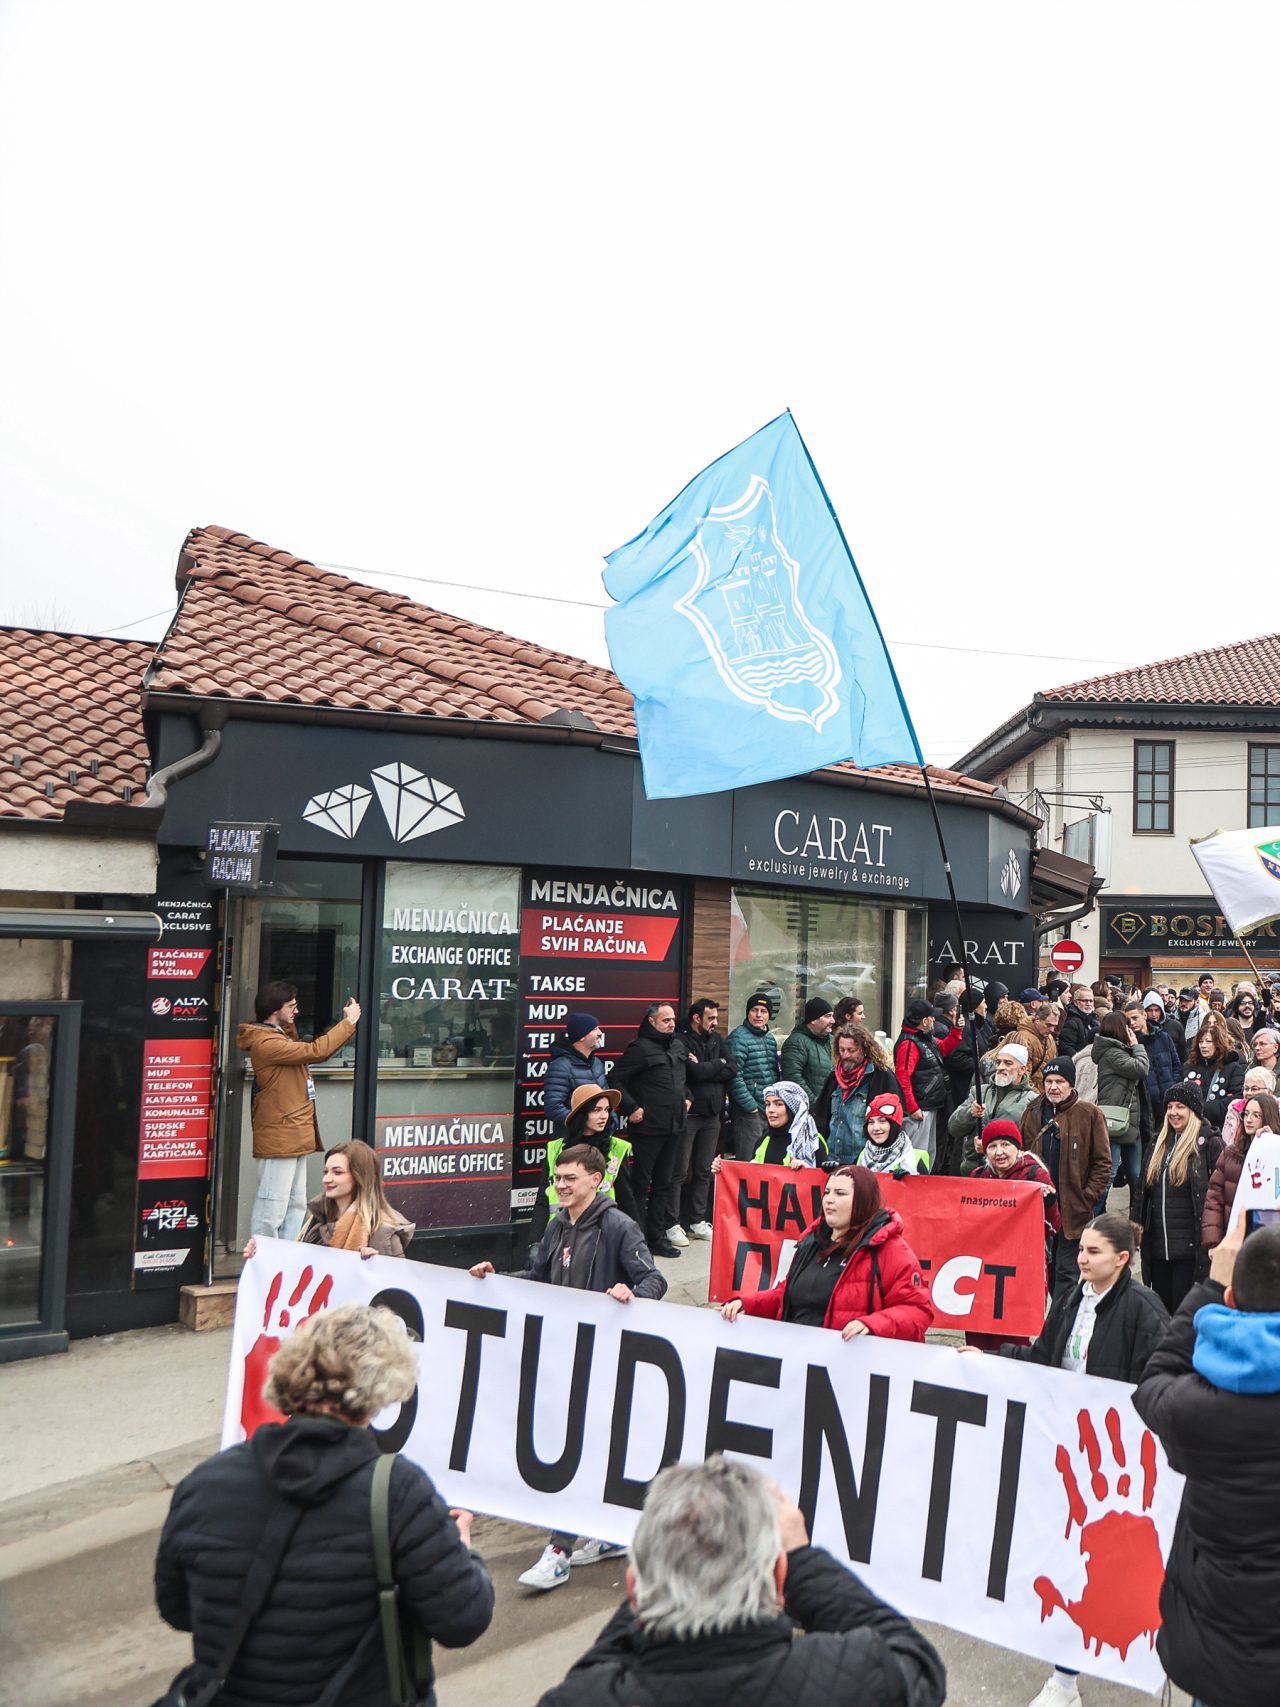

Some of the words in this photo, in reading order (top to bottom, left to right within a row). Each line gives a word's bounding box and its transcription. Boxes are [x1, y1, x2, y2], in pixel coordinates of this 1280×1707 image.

[774, 809, 892, 867] CARAT
[749, 858, 805, 876] exclusive
[808, 863, 849, 884] jewelry
[852, 868, 858, 882] &
[861, 872, 909, 890] exchange
[531, 879, 678, 911] MENJAČNICA
[157, 901, 212, 909] MENJAČNICA
[167, 912, 201, 920] CARAT
[393, 902, 511, 935] MENJAČNICA
[162, 923, 212, 931] XCLUSIVE
[542, 914, 624, 934] PLAĆANJE
[541, 936, 580, 952] SVIH
[583, 936, 647, 954] RAČUNA
[1168, 939, 1215, 947] EXCLUSIVE
[153, 950, 204, 959] PLAĆANJE
[391, 945, 463, 965] EXCHANGE
[467, 947, 511, 966] OFFICE
[929, 939, 1025, 965] ARAT
[152, 968, 194, 976] RAČUNA
[530, 975, 586, 992] TAKSE
[391, 977, 511, 1000] CARAT
[174, 998, 208, 1006] ALTA
[173, 1007, 199, 1016] PAY
[528, 1004, 568, 1020] MUP
[148, 1056, 181, 1064] TAKSE
[147, 1069, 171, 1077] MUP
[147, 1082, 192, 1090] TELEFON
[145, 1096, 198, 1104] KATASTAR
[145, 1108, 205, 1117] KOMUNALIJE
[145, 1122, 185, 1130] SUDSKE
[144, 1130, 177, 1138] TAKSE
[385, 1117, 504, 1147] MENJAČNICA
[143, 1141, 196, 1150] PLAĆANJE
[143, 1149, 203, 1159] KARTICAMA
[383, 1154, 456, 1176] EXCHANGE
[460, 1153, 504, 1173] OFFICE
[154, 1200, 188, 1208] ALTA
[960, 1195, 1017, 1209] #nasprotest
